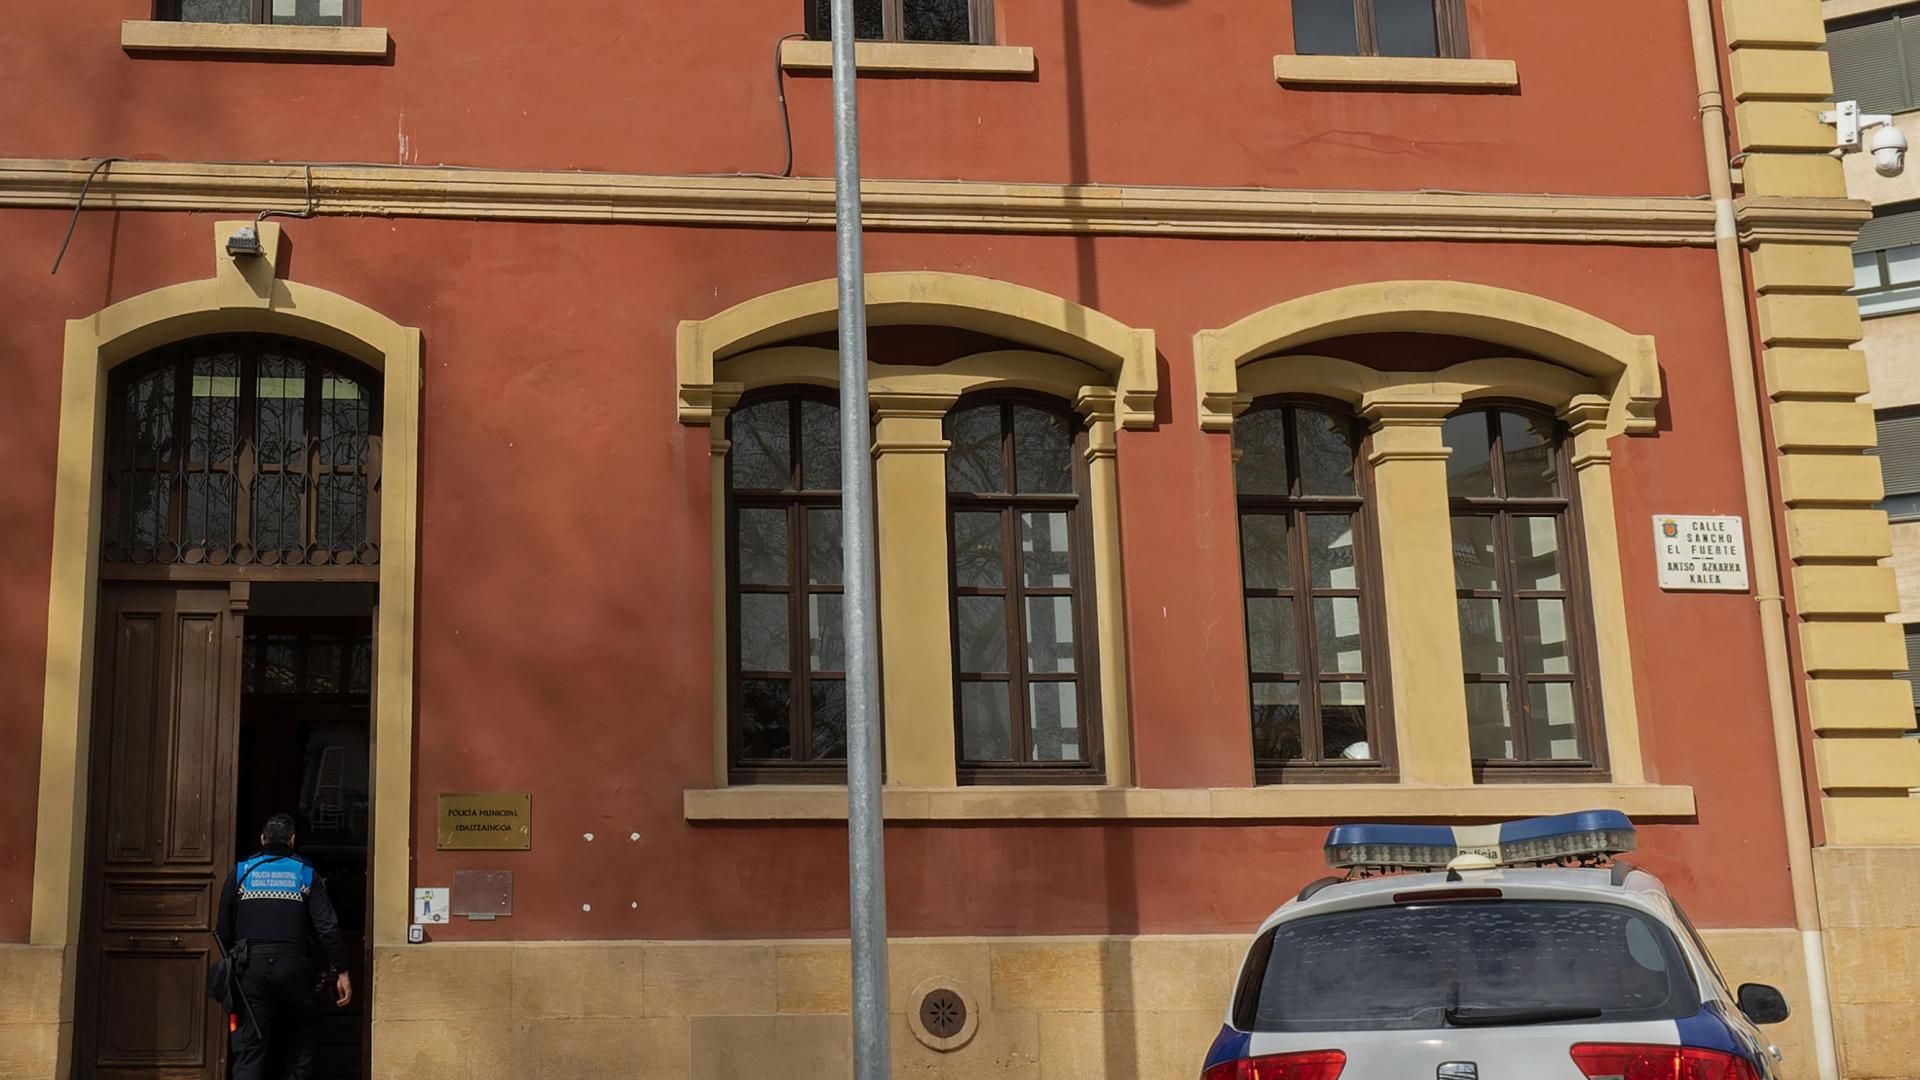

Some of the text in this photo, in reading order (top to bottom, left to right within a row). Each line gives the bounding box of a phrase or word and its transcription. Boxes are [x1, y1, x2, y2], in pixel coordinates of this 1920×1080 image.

[1692, 522, 1725, 531] CALLE
[1686, 533, 1733, 543] SANCHO
[1667, 545, 1736, 555] EL FUERTE
[1702, 563, 1742, 572] AZKARRA
[1689, 575, 1721, 583] KALEA
